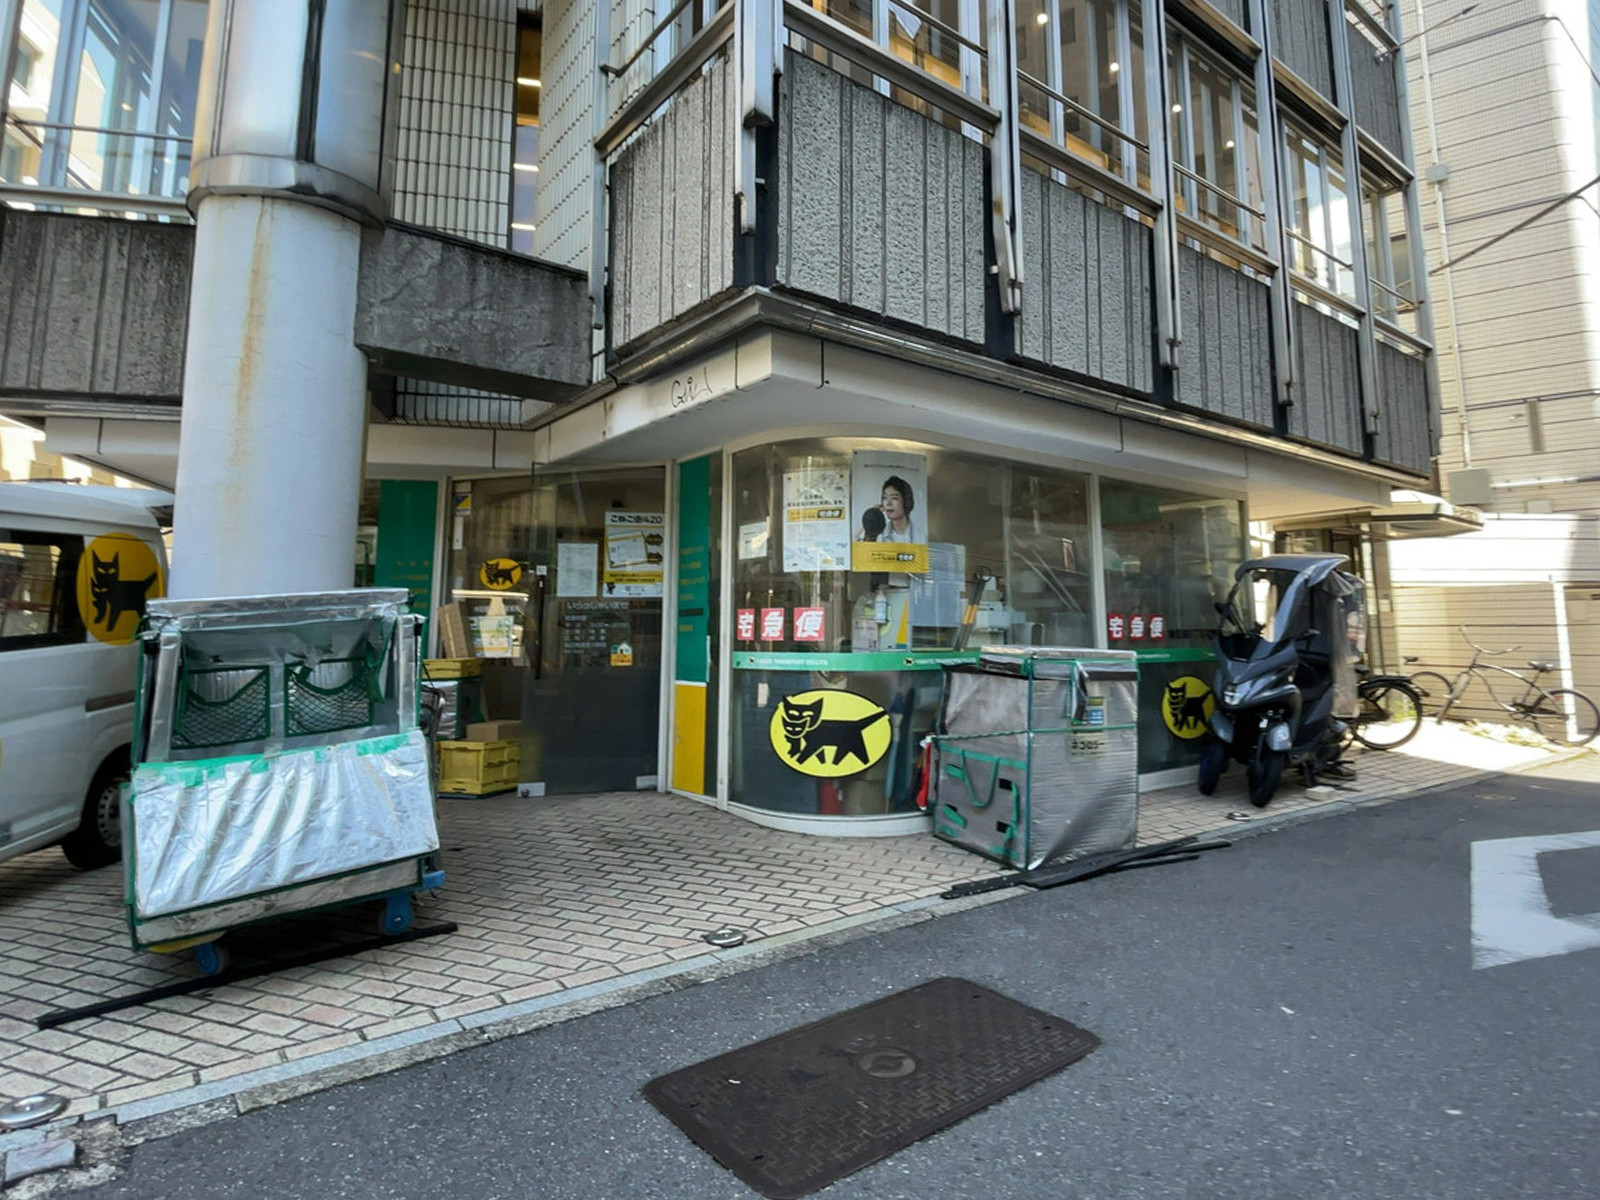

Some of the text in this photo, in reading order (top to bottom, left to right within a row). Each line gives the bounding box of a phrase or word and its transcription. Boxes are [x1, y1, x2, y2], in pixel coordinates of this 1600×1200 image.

[566, 600, 629, 610] いらっしゃいませ
[738, 610, 824, 639] 宅急便
[1109, 615, 1164, 638] 宅急便
